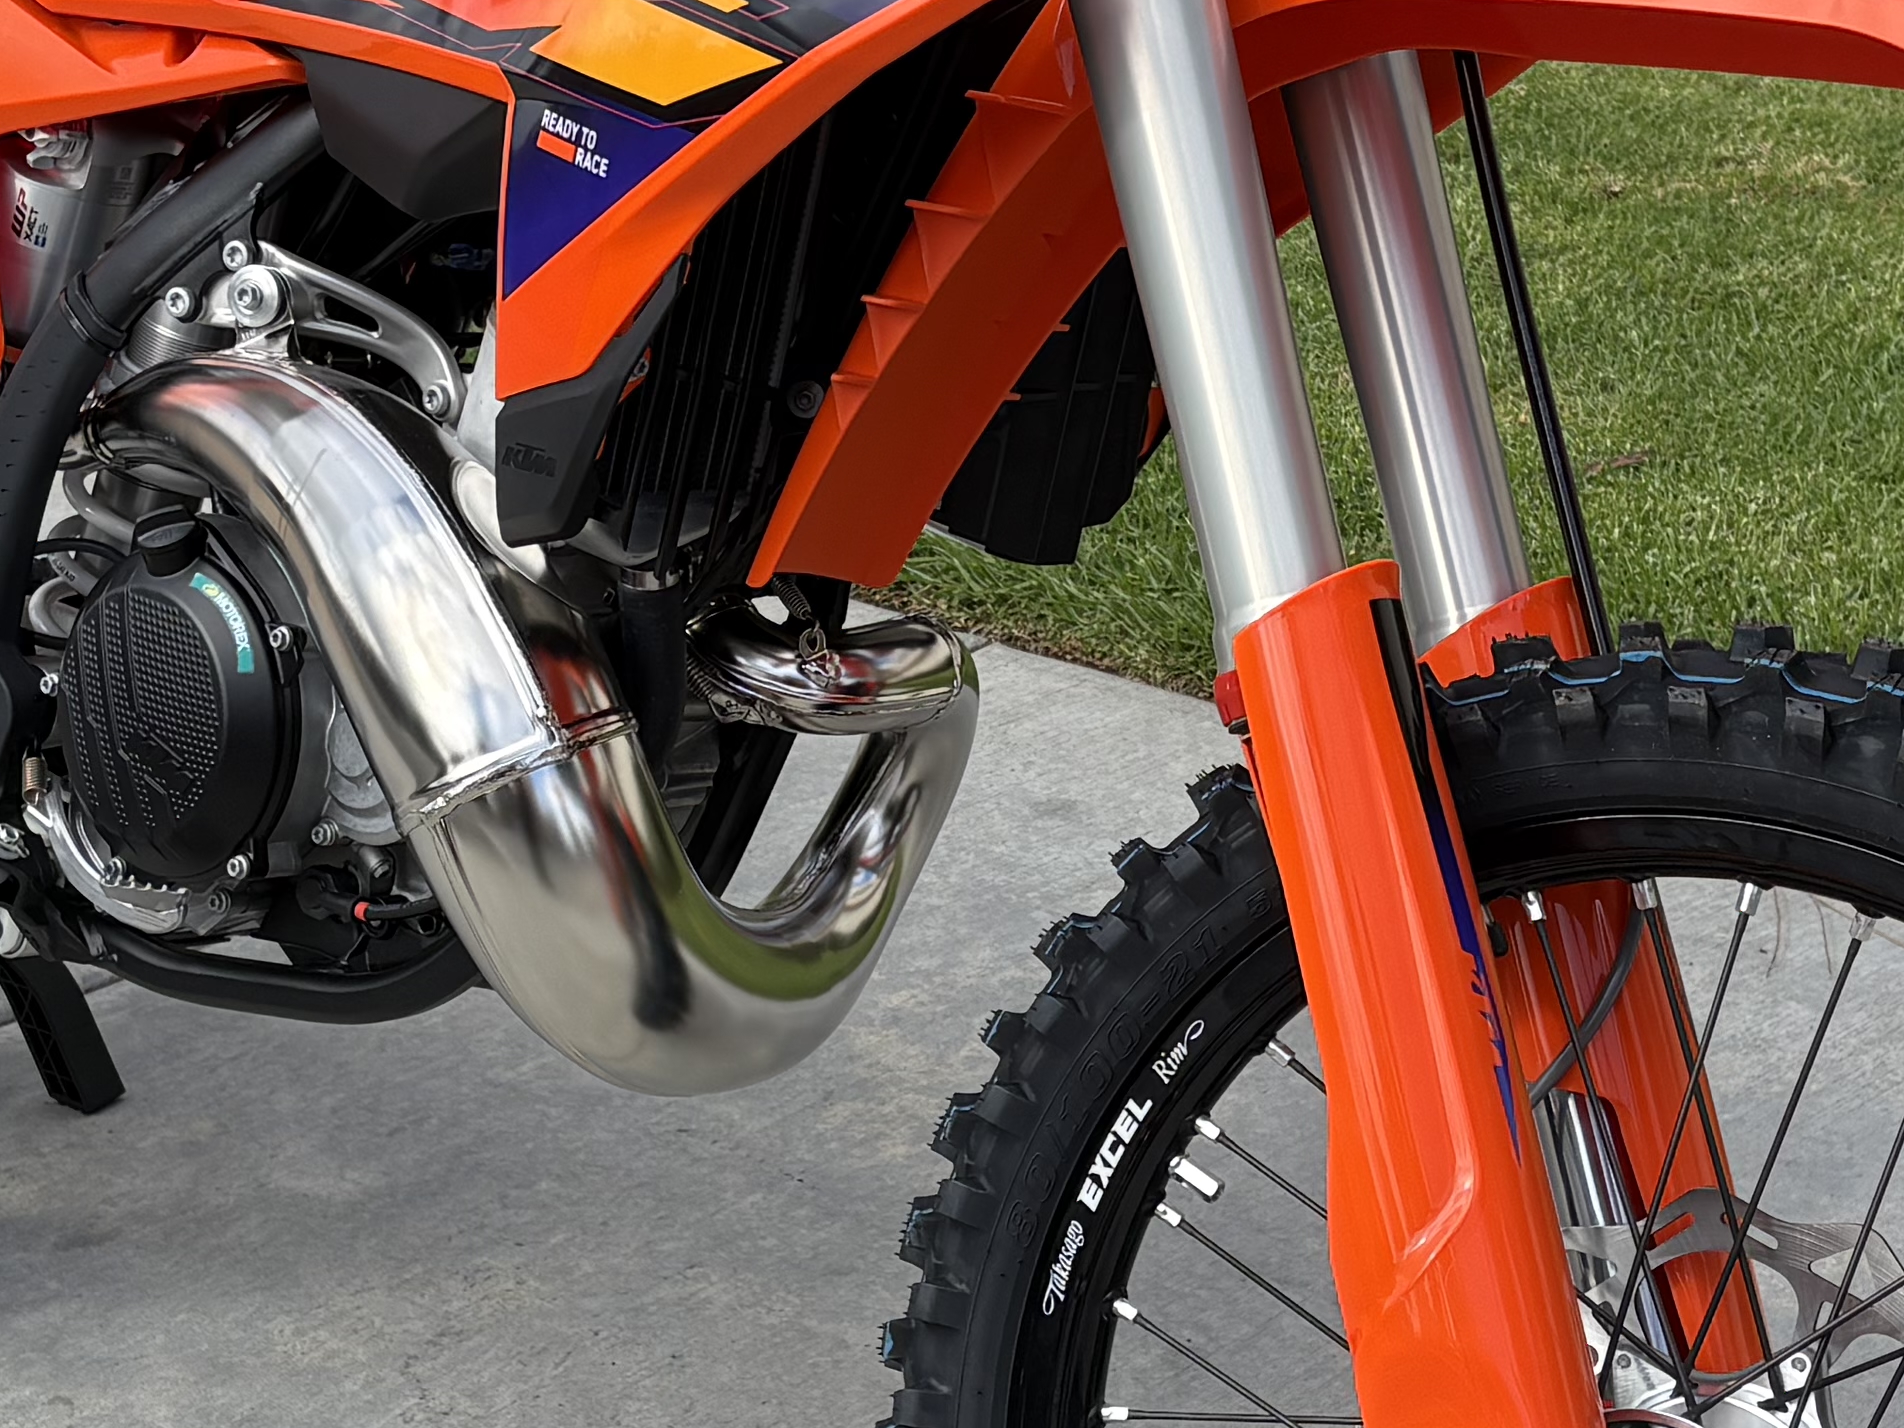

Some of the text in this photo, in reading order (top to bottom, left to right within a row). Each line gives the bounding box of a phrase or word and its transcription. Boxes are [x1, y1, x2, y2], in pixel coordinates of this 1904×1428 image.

[541, 108, 598, 150] READY TO
[575, 147, 609, 178] RACE
[501, 441, 558, 478] KTM
[213, 591, 251, 652] MOTOREX
[1042, 1019, 1205, 1315] Takasago EXCEL Rim
